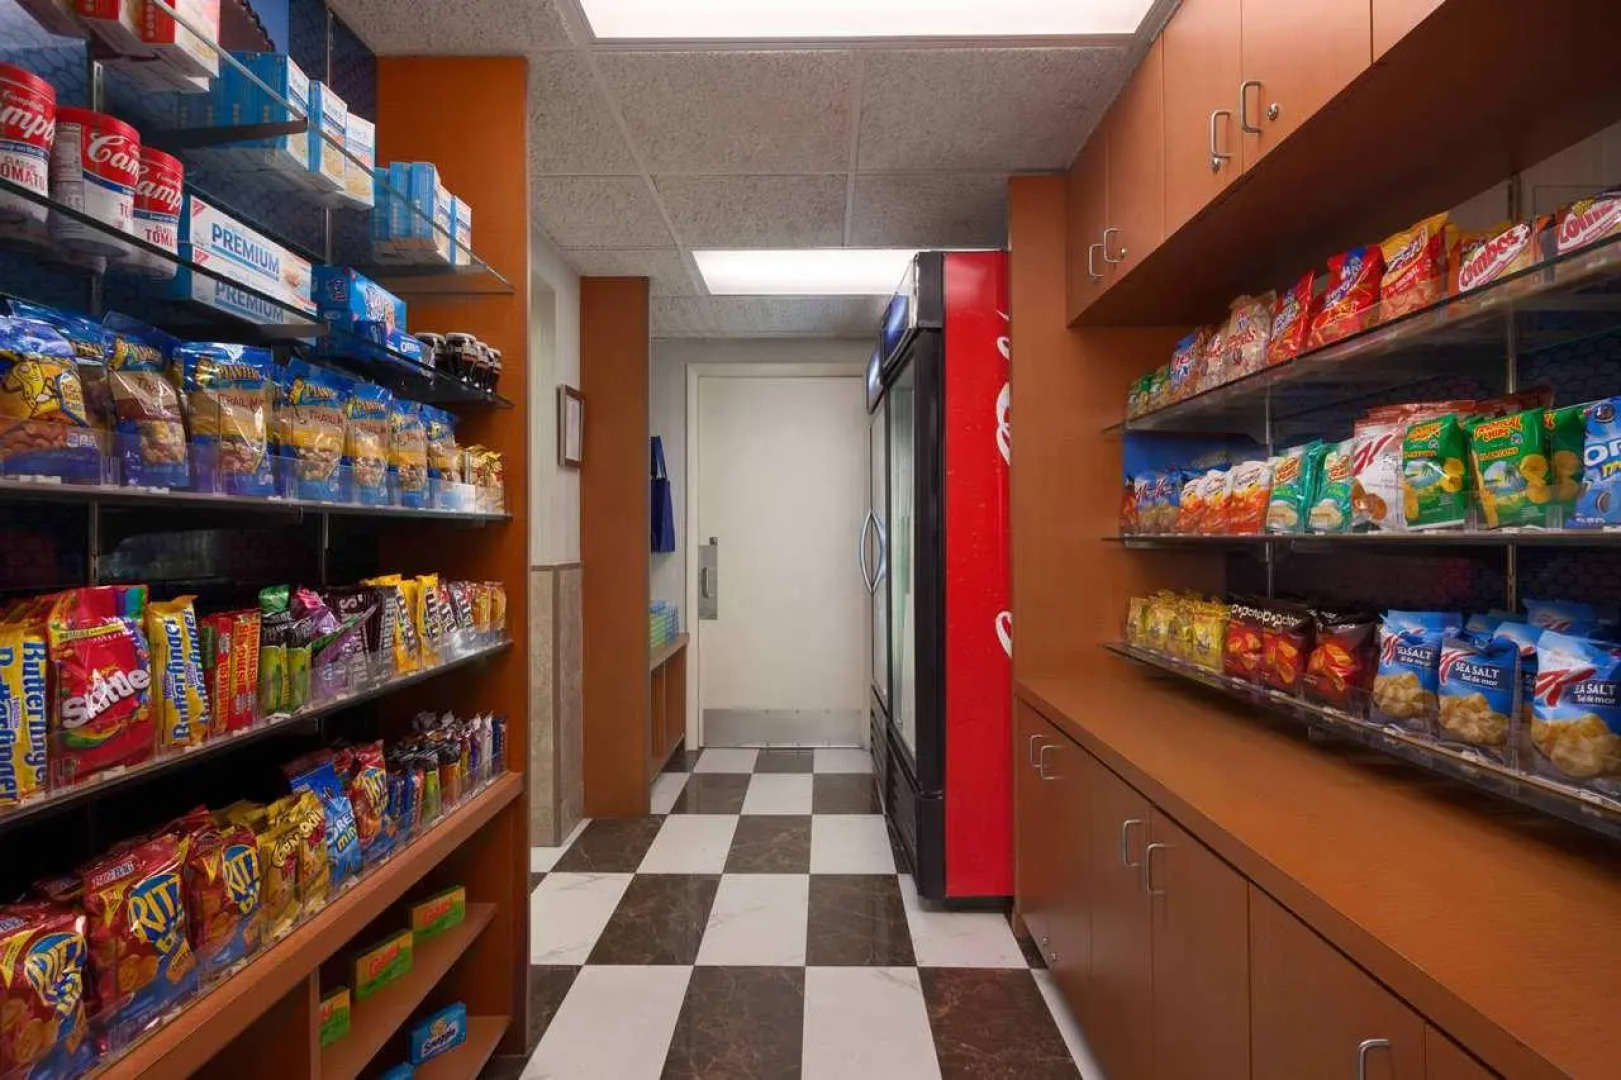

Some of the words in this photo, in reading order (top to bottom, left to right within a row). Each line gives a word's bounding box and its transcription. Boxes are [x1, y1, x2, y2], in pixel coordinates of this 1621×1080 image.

[211, 222, 281, 275] PREMIUM
[214, 281, 285, 323] PREMIUM
[1455, 661, 1471, 675] SEA
[1471, 666, 1501, 679] SALT
[1586, 683, 1617, 696] SALT
